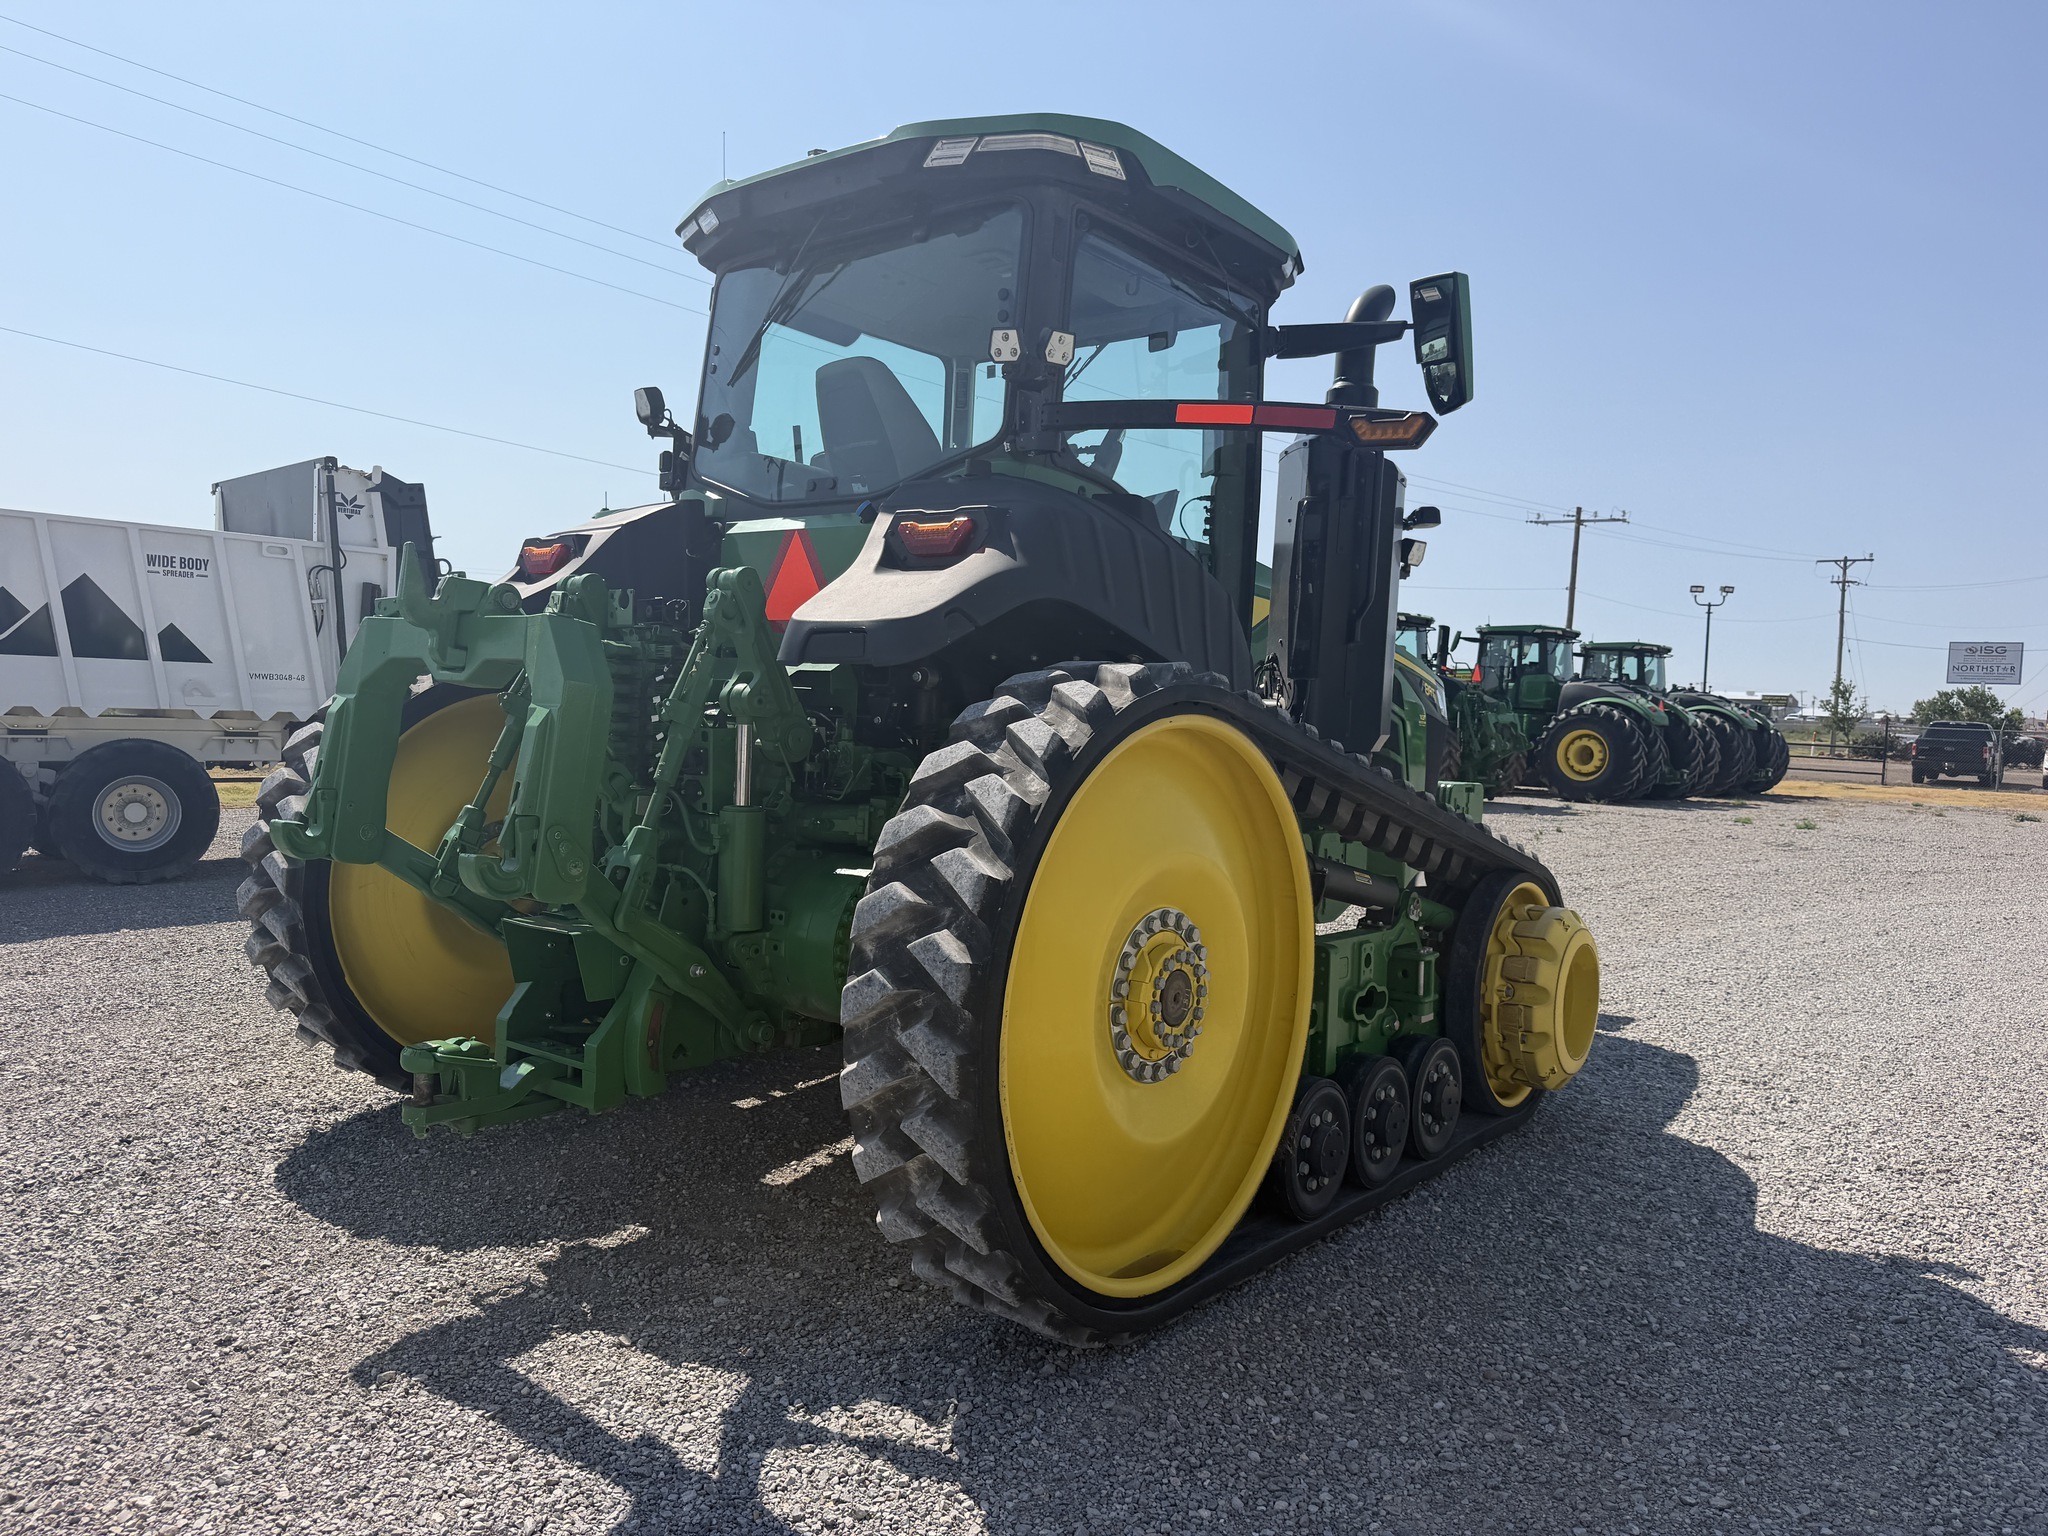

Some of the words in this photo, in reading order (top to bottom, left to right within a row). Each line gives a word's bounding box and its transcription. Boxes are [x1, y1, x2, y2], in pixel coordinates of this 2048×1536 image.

[146, 554, 177, 569] WIDE
[180, 556, 209, 571] BODY
[162, 569, 194, 578] SPREADER
[1980, 646, 2007, 654] ISG
[248, 672, 306, 682] VMWB3048-48
